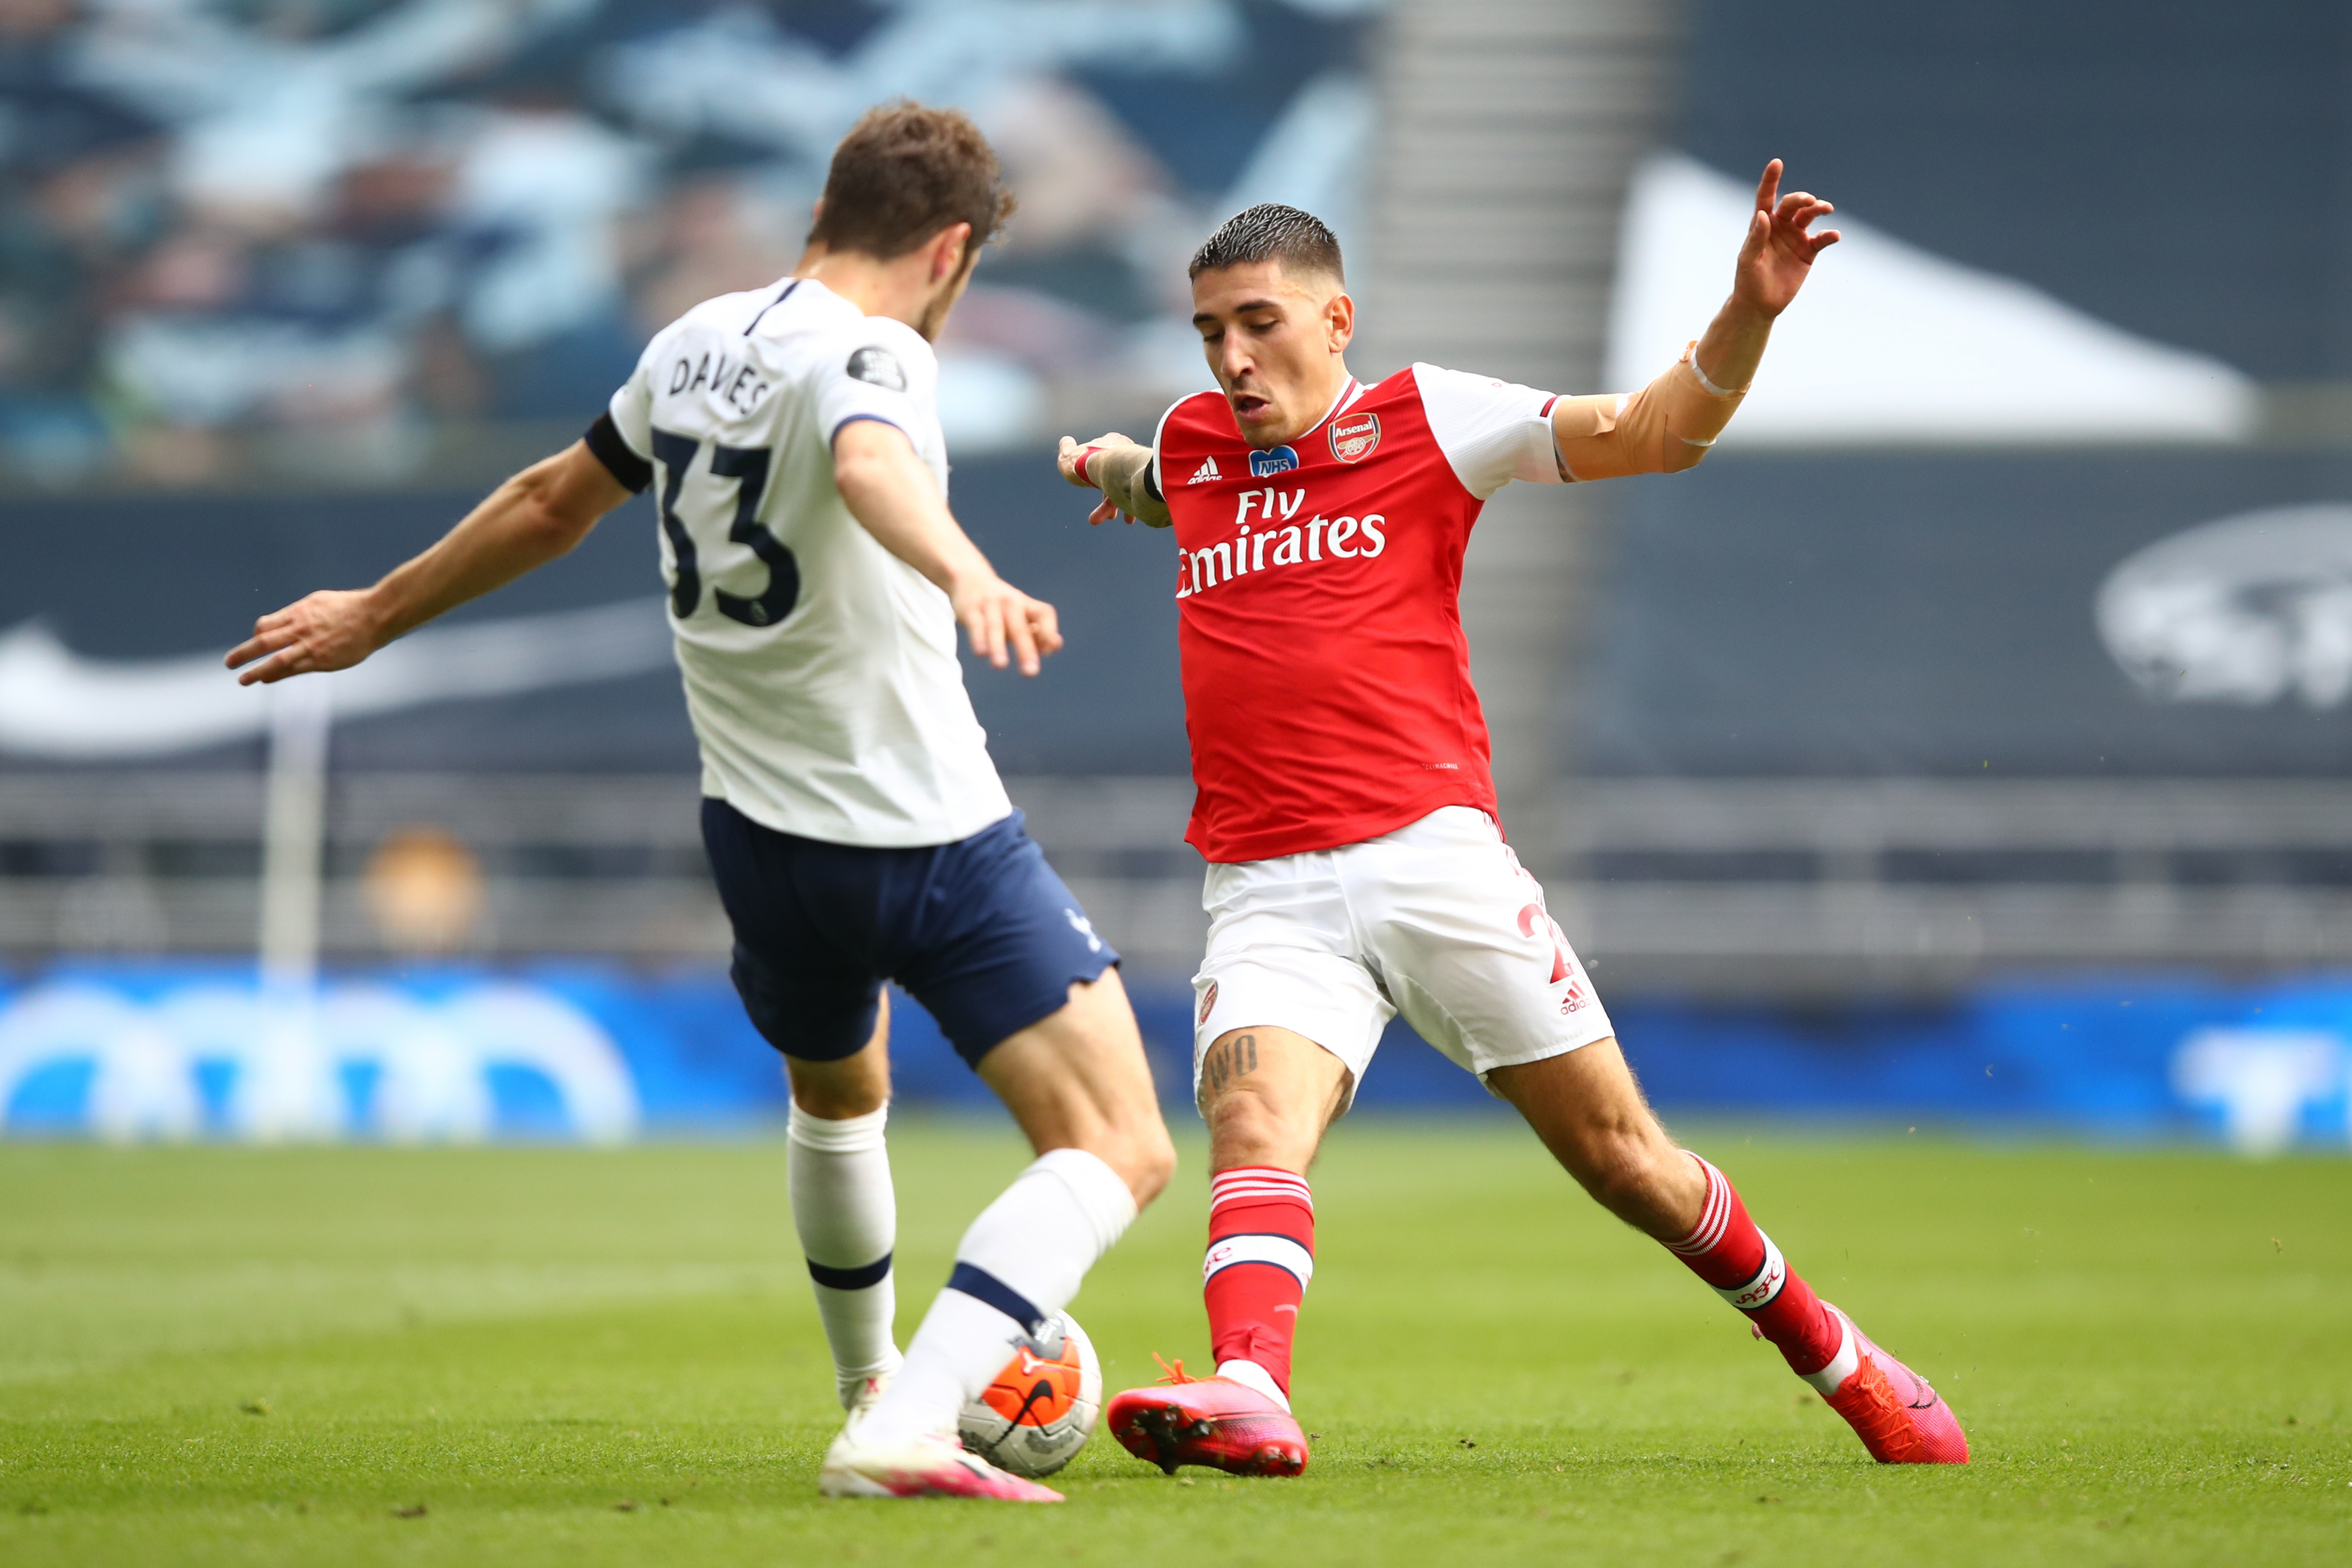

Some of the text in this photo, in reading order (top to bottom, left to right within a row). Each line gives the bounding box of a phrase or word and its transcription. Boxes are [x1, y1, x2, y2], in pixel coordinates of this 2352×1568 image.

[1335, 420, 1373, 437] Arsenal
[1260, 460, 1289, 474] NHS
[1235, 487, 1306, 524] Fly
[651, 429, 800, 627] 33
[1176, 513, 1385, 598] Emirates
[1517, 903, 1574, 984] 2
[1560, 997, 1592, 1016] adida
